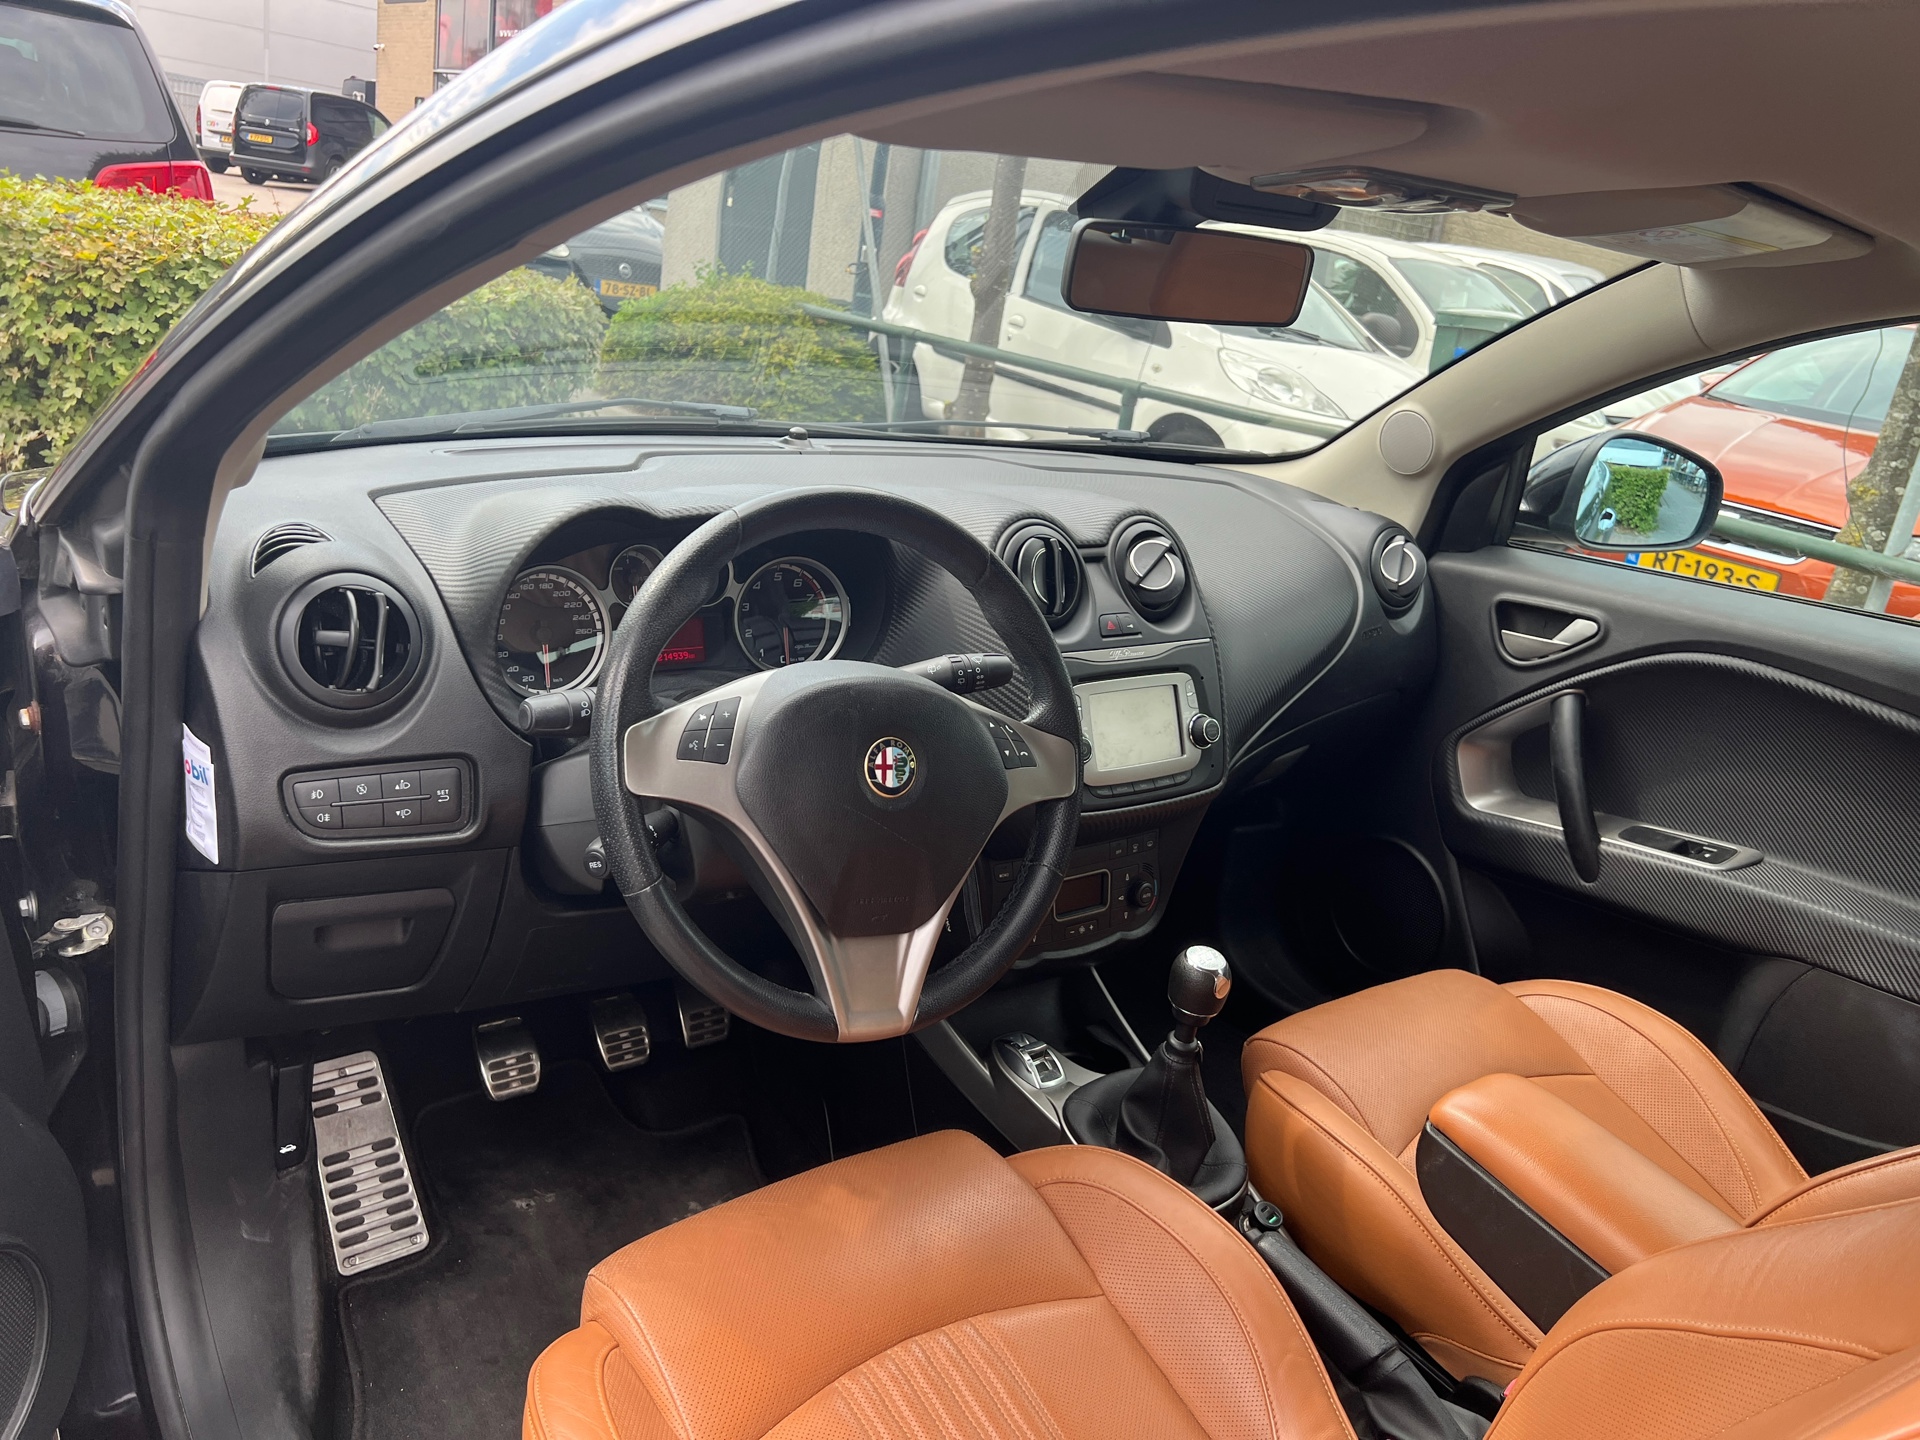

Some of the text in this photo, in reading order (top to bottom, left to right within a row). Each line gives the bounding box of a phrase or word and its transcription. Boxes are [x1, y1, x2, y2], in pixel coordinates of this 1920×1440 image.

[752, 581, 761, 590] 4
[793, 579, 803, 587] 6
[741, 603, 750, 611] 3
[745, 629, 753, 638] 2
[759, 649, 764, 657] 1
[868, 742, 886, 768] ALFA
[184, 759, 209, 785] obil
[589, 861, 602, 869] RES
